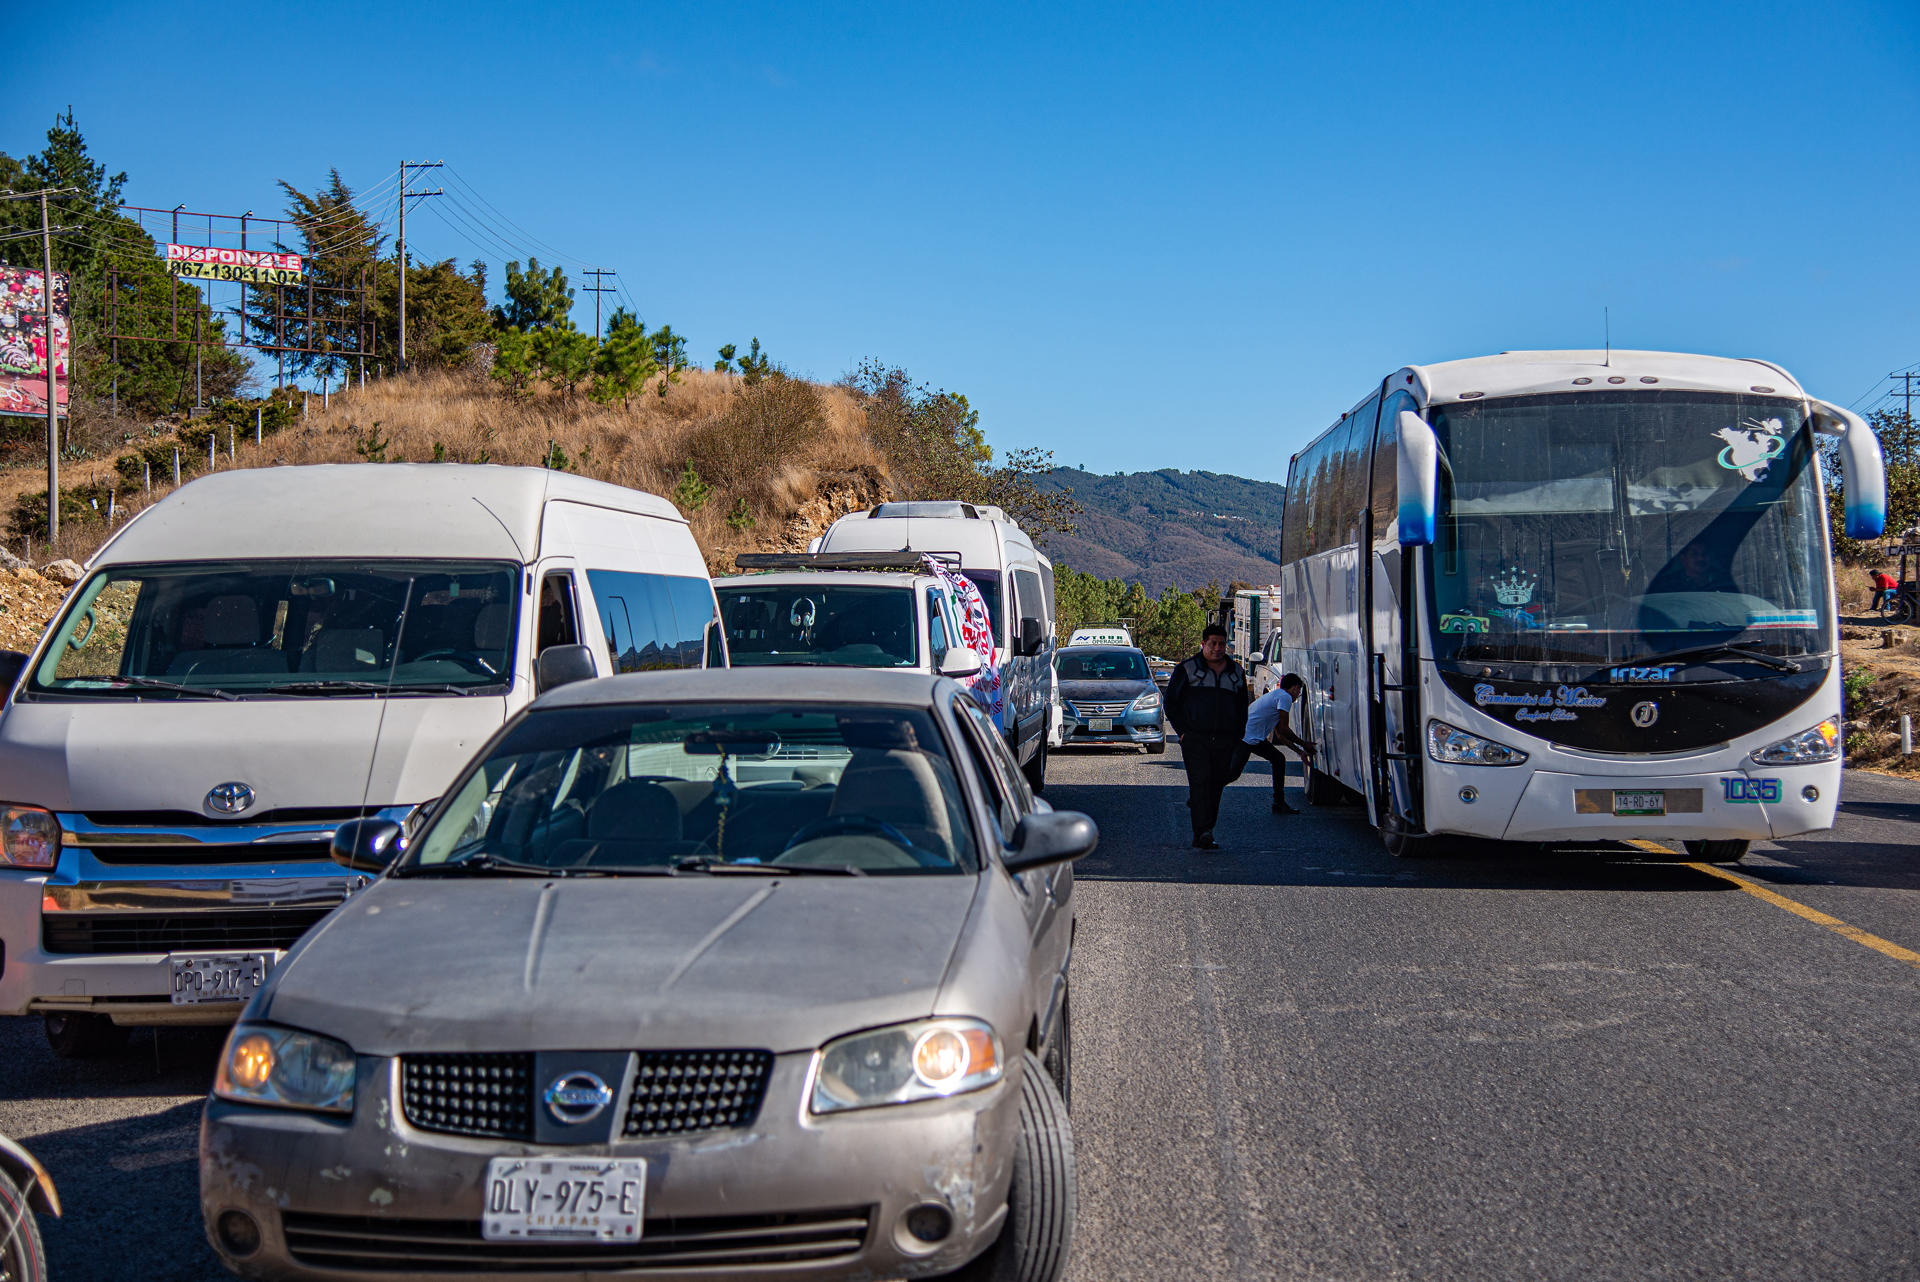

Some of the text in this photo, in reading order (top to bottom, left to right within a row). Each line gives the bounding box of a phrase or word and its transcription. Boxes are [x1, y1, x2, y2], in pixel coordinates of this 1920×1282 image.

[168, 244, 300, 270] DISPONIBLE
[1538, 690, 1554, 706] de
[1719, 777, 1782, 803] 1035
[490, 1179, 638, 1216] DLY-975-E
[526, 1215, 601, 1226] CHIAPAS
